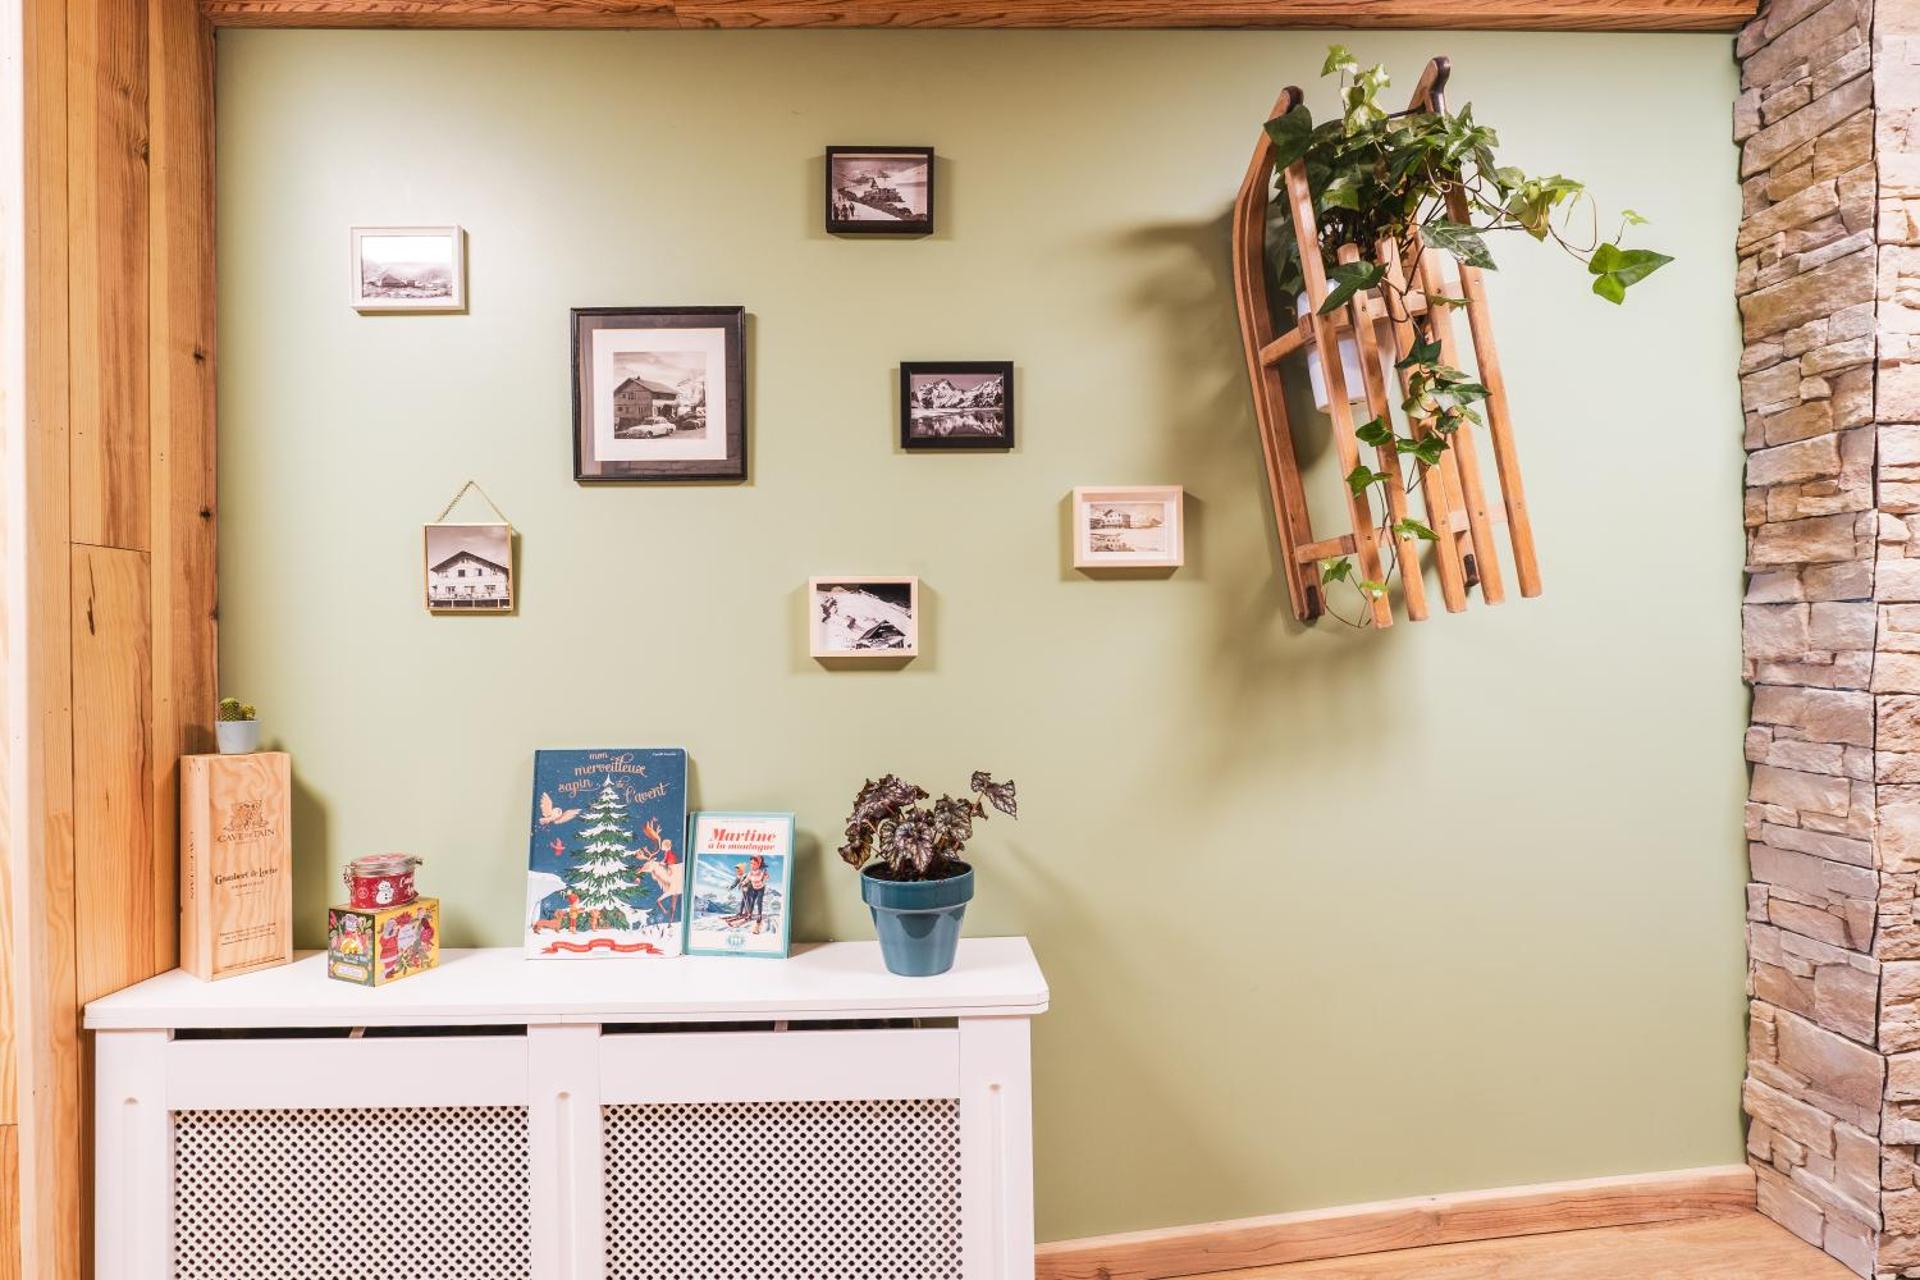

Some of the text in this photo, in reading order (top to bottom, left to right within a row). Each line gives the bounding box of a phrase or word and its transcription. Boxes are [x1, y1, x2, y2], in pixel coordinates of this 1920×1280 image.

[589, 752, 608, 760] mon
[574, 752, 648, 778] merveilleux
[558, 779, 599, 798] sapin
[216, 833, 243, 843] CAVE
[712, 828, 777, 842] Martine
[716, 842, 727, 850] la
[728, 842, 776, 852] montagne
